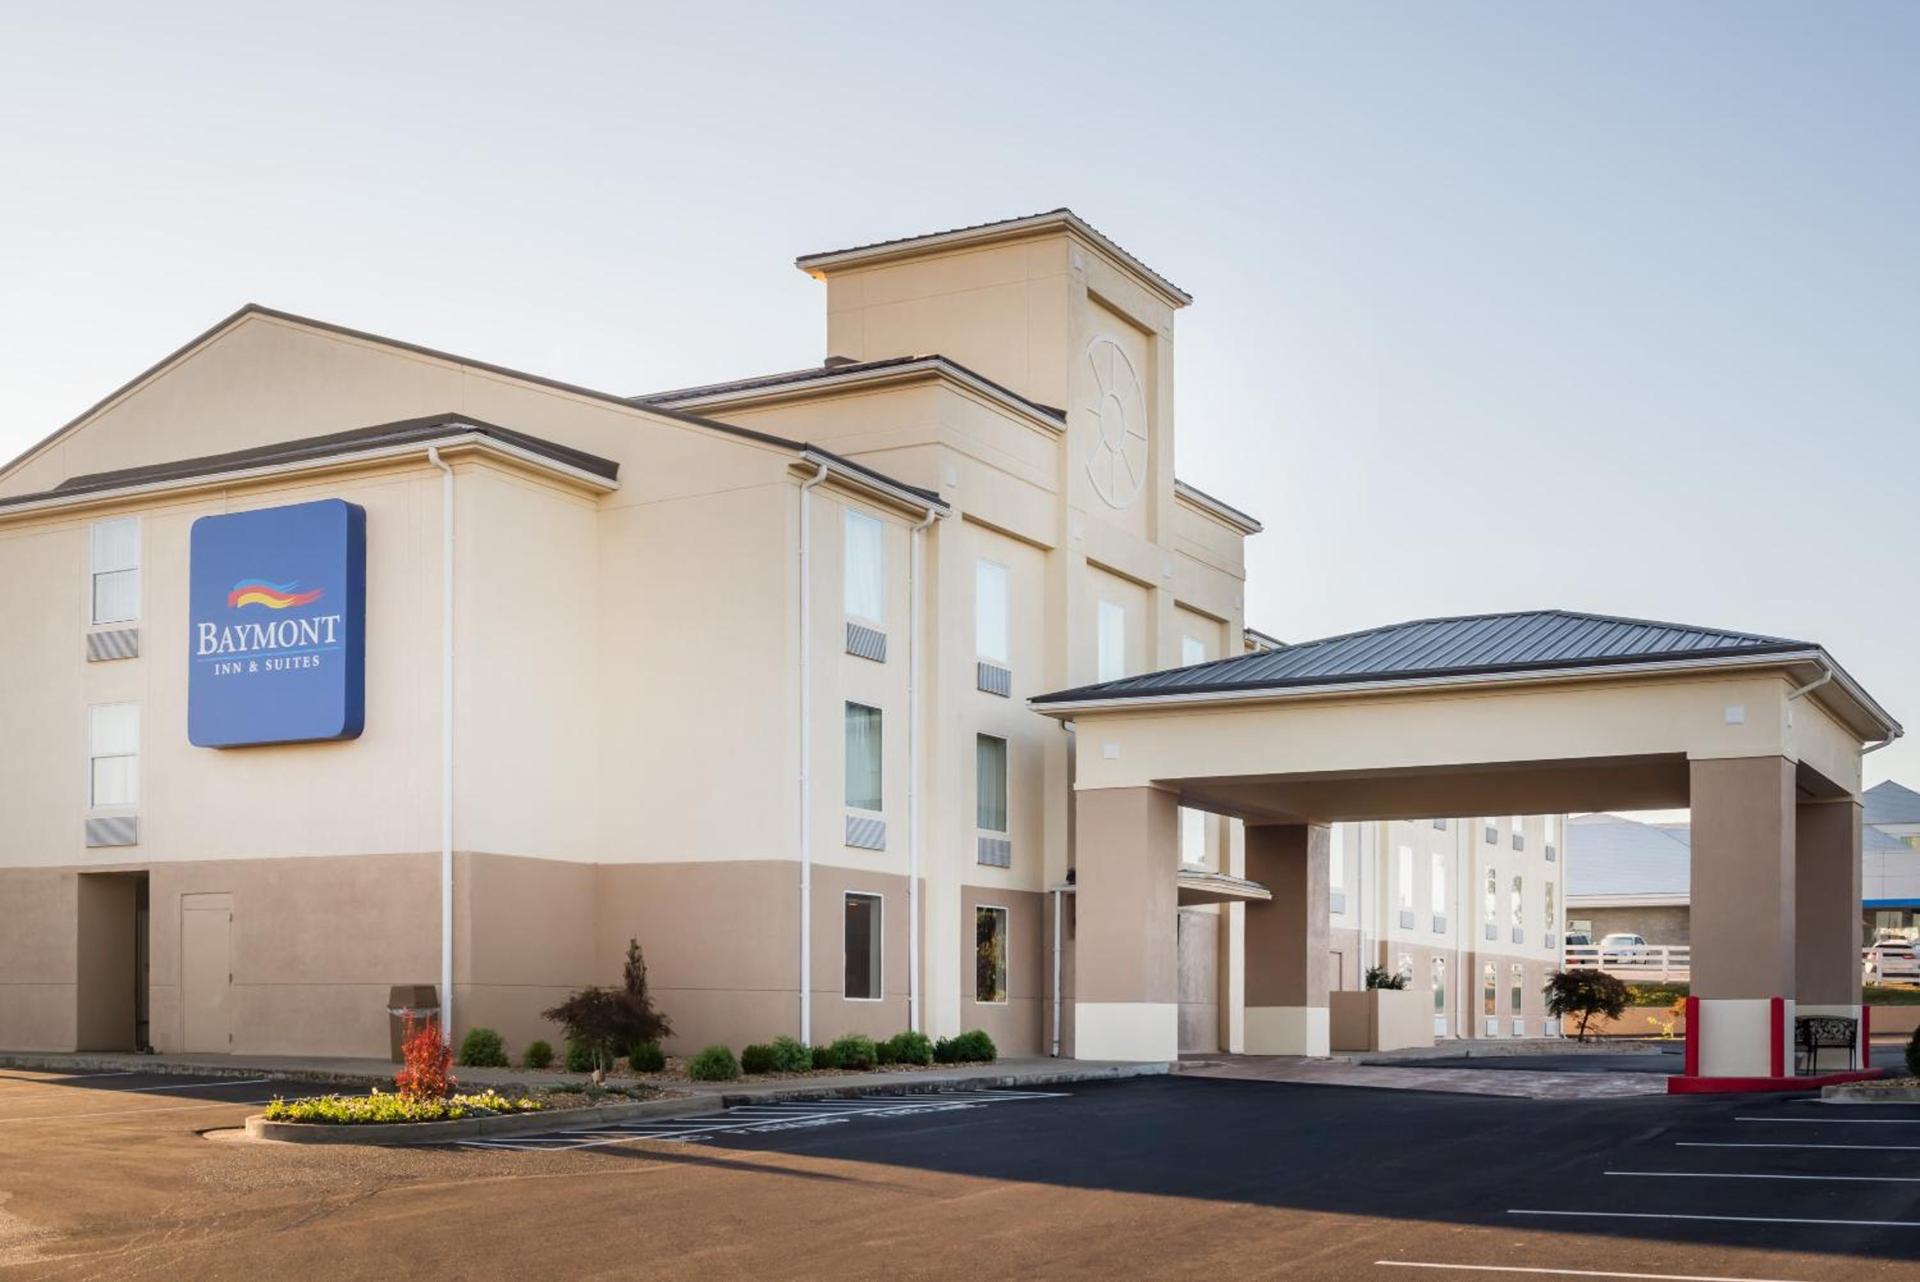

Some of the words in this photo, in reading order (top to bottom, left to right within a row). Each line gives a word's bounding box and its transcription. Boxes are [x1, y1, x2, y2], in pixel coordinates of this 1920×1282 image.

[197, 614, 341, 655] BAYMONT
[214, 662, 242, 676] INN
[248, 660, 259, 673] &
[265, 655, 320, 671] SUITES
